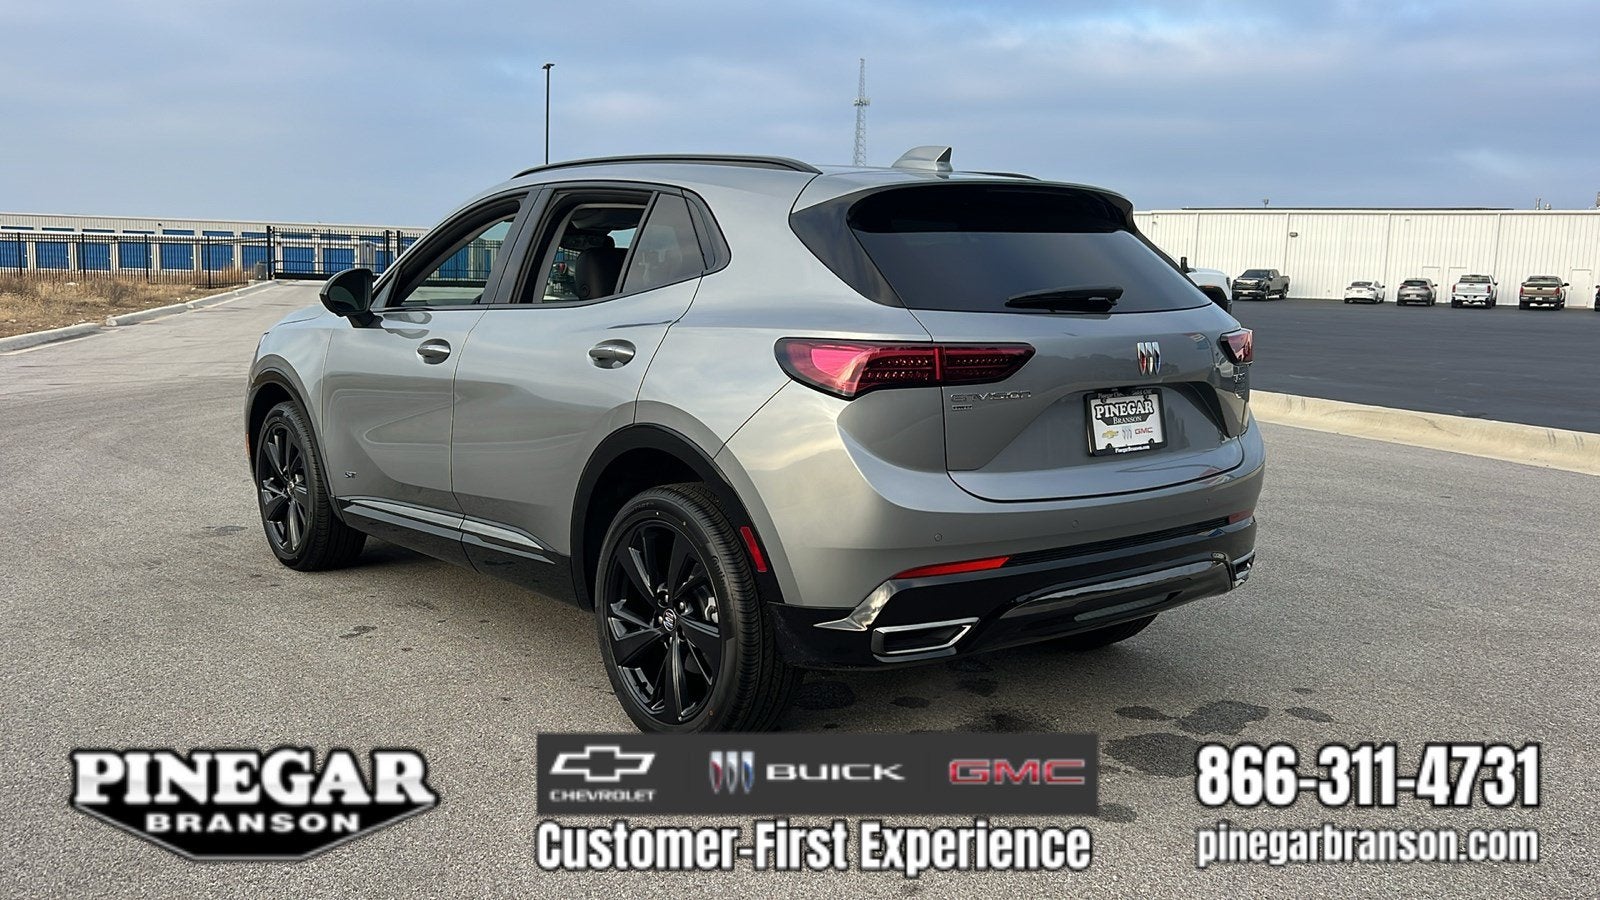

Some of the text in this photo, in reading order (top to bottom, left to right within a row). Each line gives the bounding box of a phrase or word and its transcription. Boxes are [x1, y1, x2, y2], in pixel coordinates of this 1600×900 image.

[1095, 400, 1154, 419] PINEGAR
[1113, 415, 1142, 425] BRANSON
[1134, 427, 1154, 435] GMC
